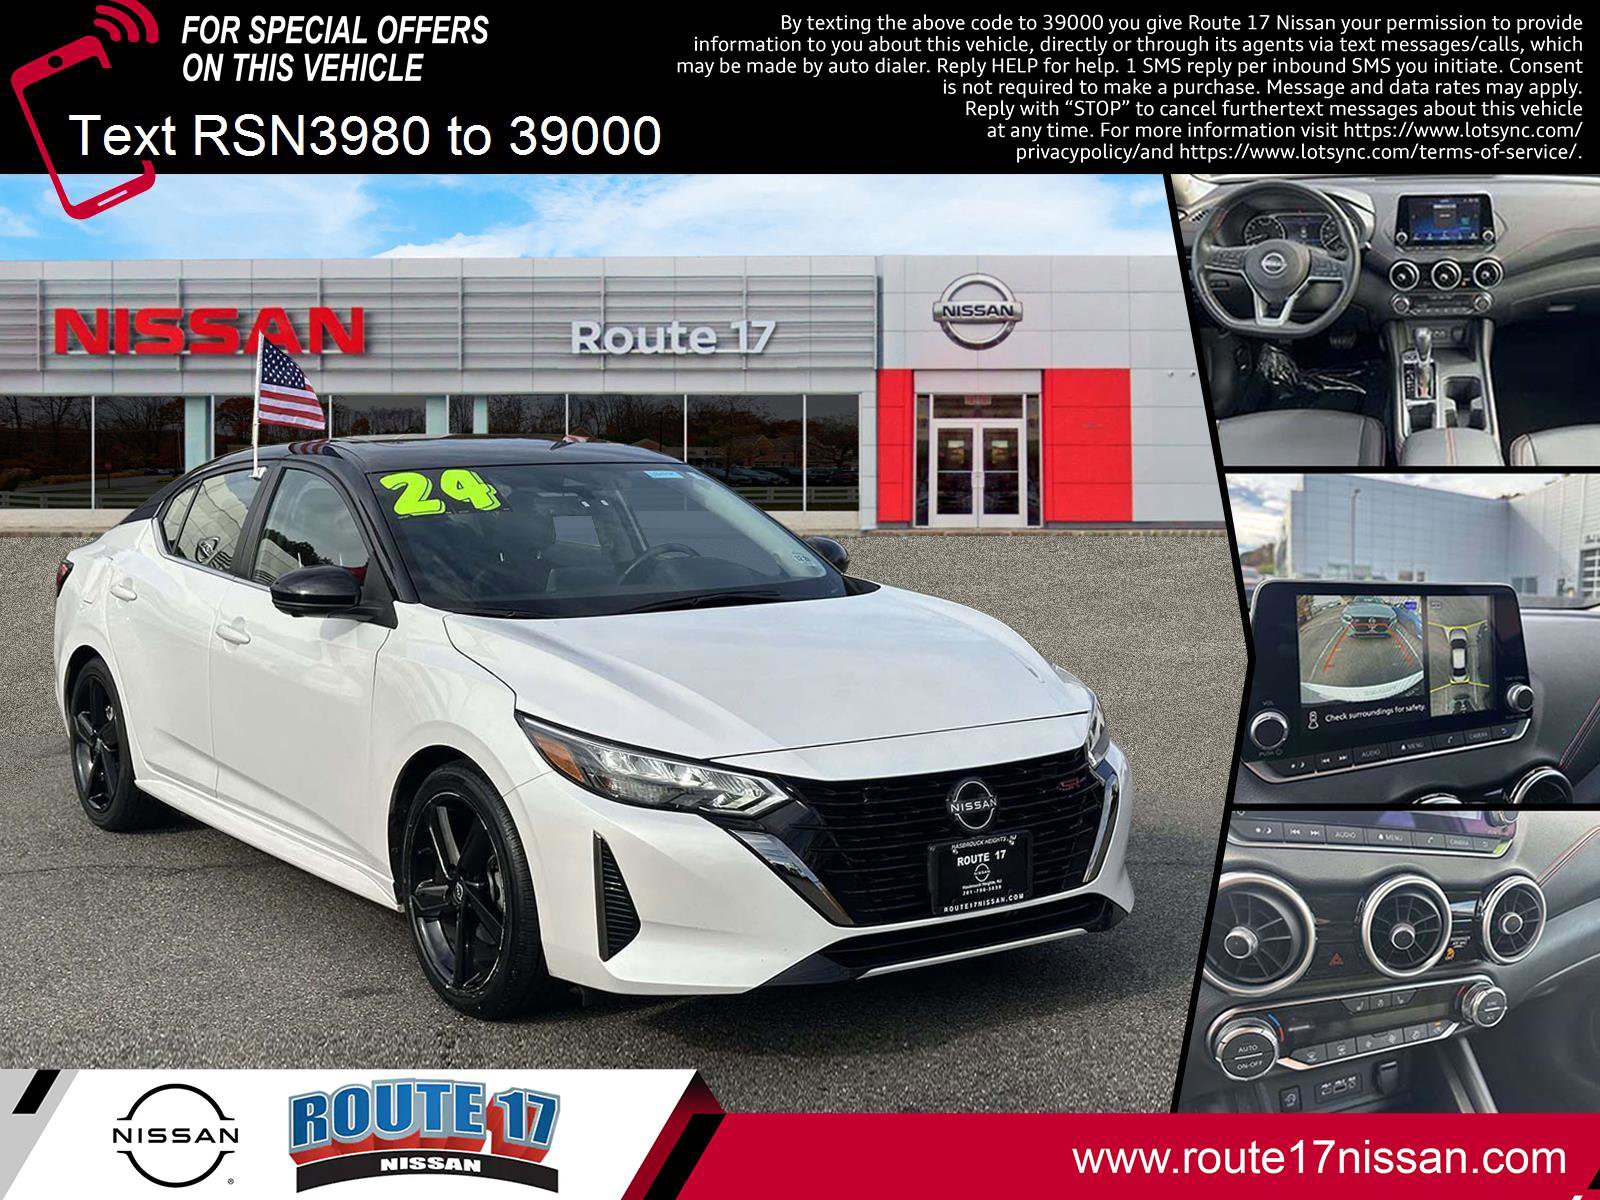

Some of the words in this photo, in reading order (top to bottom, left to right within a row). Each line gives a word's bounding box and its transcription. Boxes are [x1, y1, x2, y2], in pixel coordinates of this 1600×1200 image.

[942, 305, 1014, 316] NISSAN
[54, 307, 364, 355] NISSAN
[571, 320, 718, 354] Route
[730, 320, 776, 353] 17
[379, 469, 501, 516] 24
[1325, 713, 1347, 722] Check
[1349, 708, 1394, 720] surroundings
[1406, 703, 1426, 713] safety.
[1361, 749, 1381, 757] AUDIO
[950, 799, 997, 813] NISSAN
[1335, 831, 1356, 839] AUDIO
[1385, 834, 1403, 842] MENU
[957, 852, 990, 867] ROUTE
[995, 849, 1007, 860] 17
[943, 893, 1024, 913] ROUTE17NISSAN.COM
[1238, 1045, 1258, 1053] AUTO
[1237, 1060, 1263, 1070] ON-OFF
